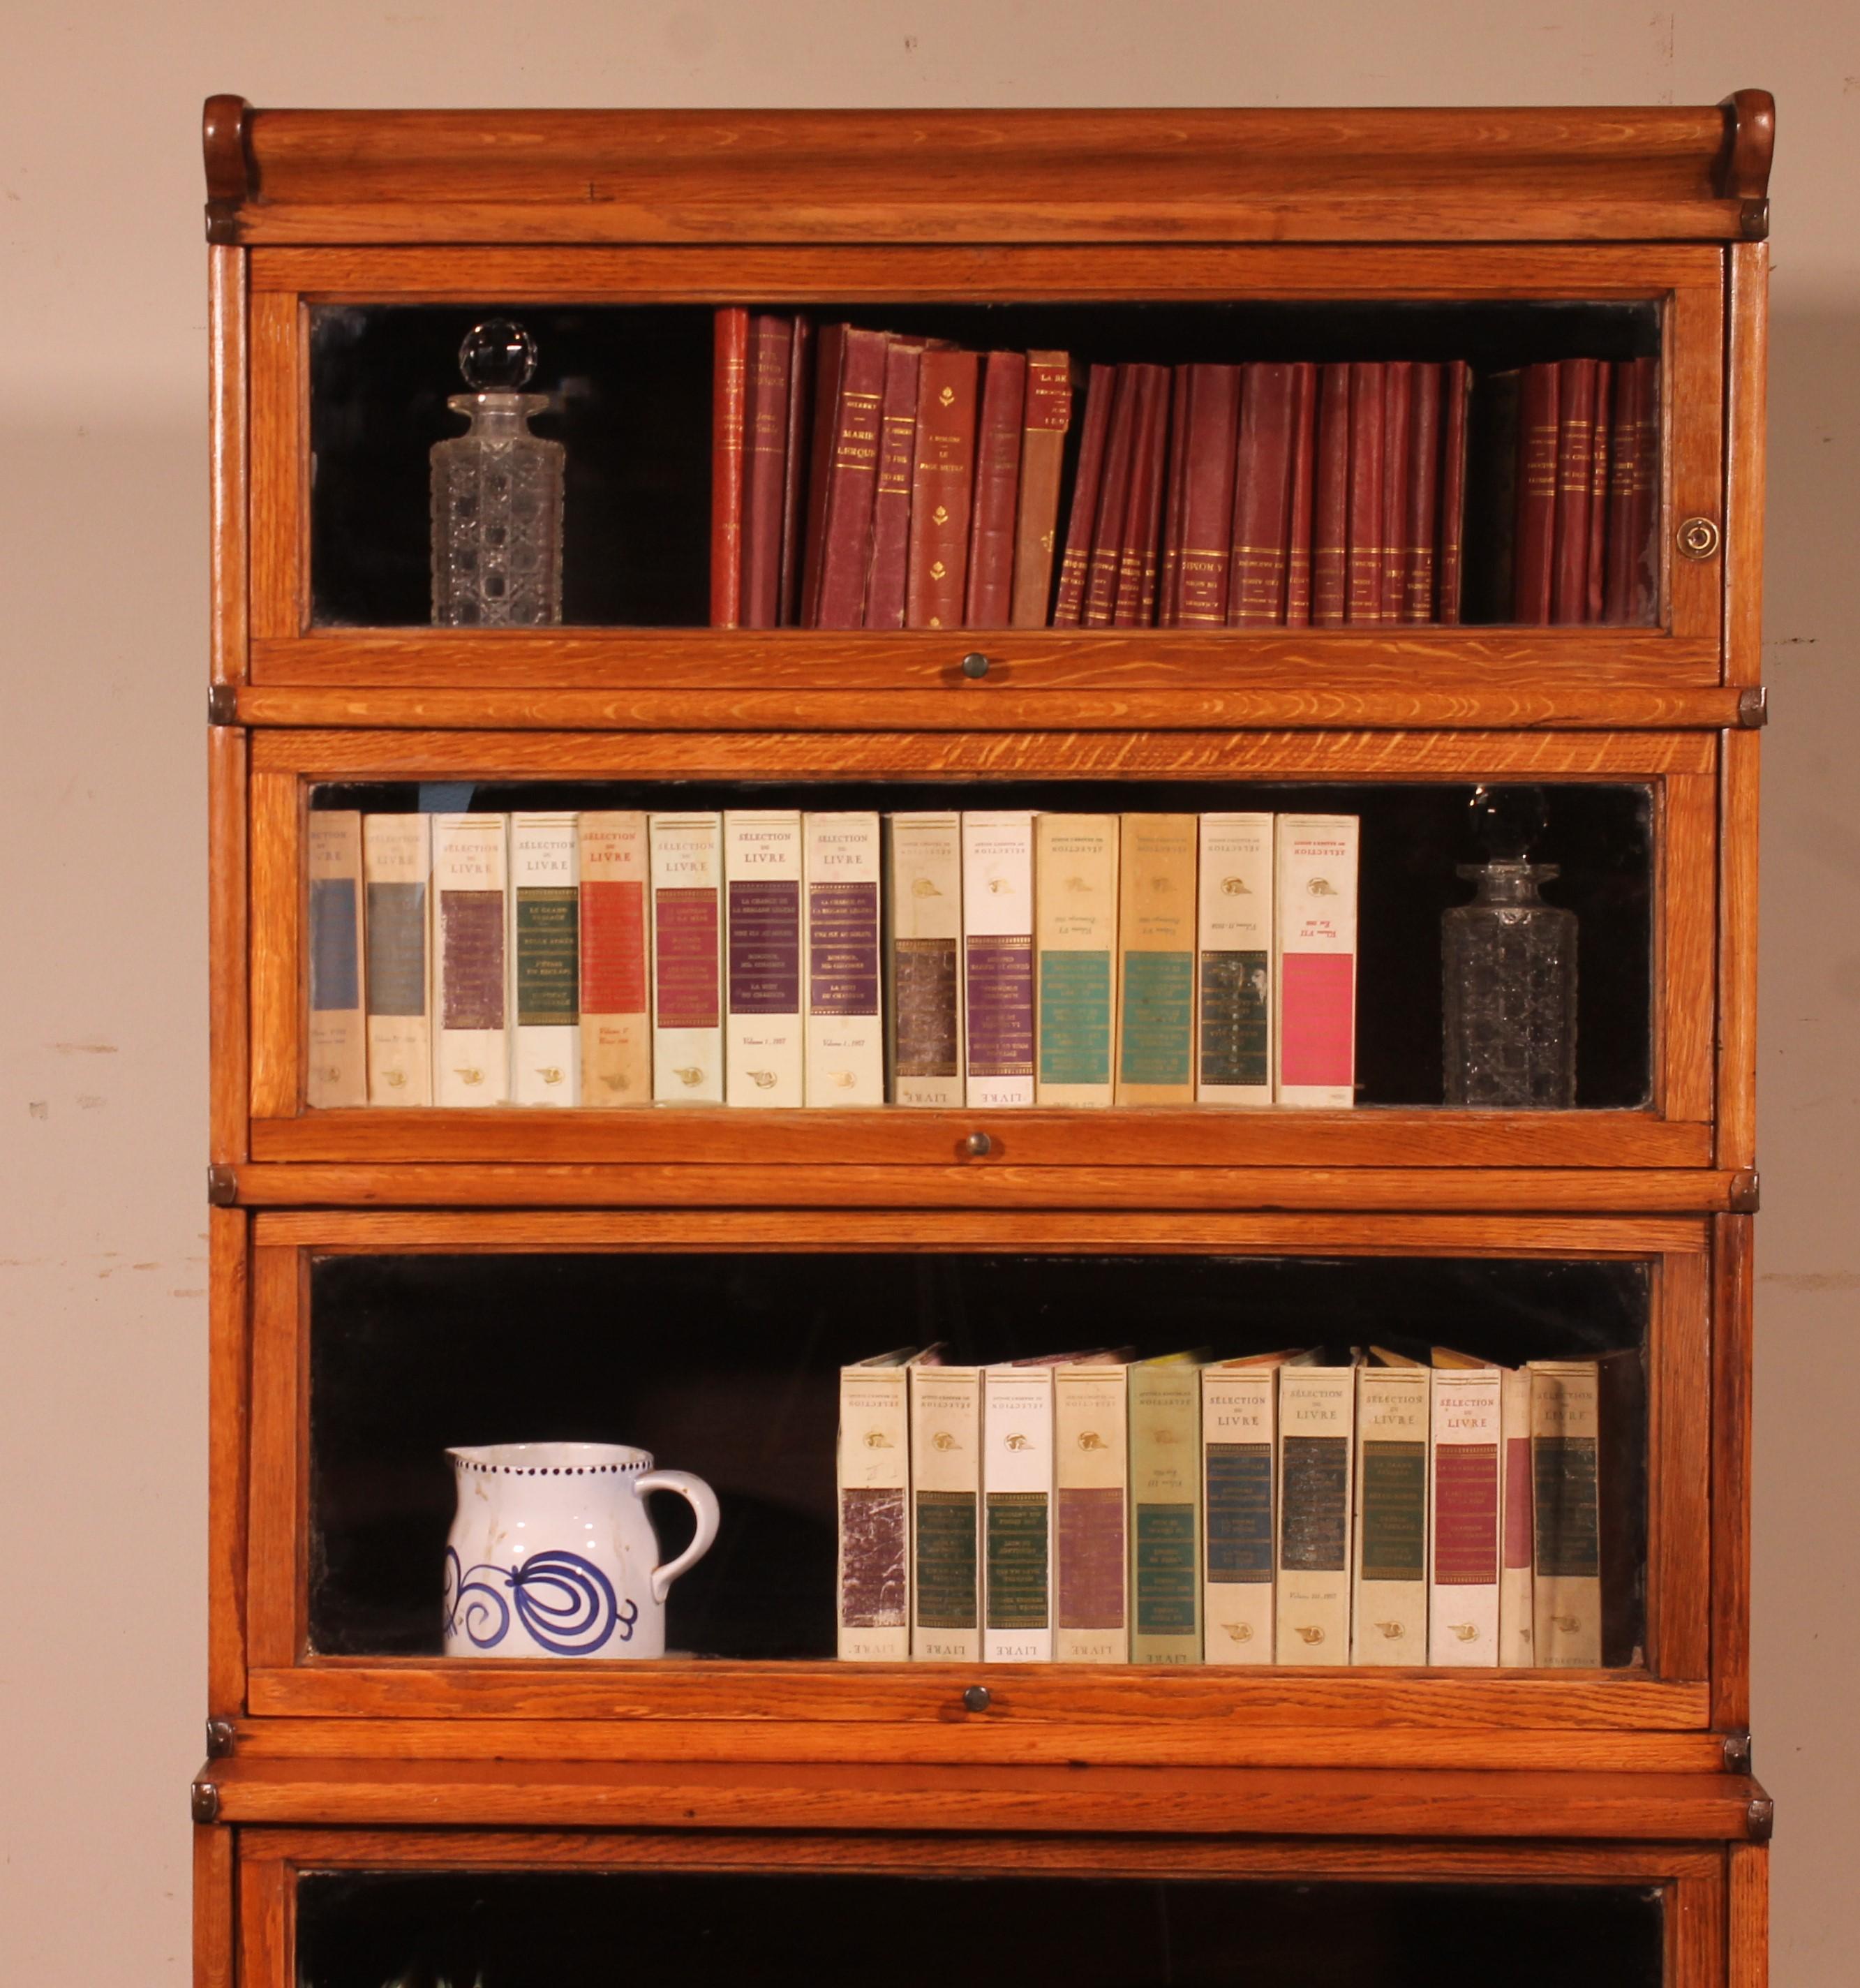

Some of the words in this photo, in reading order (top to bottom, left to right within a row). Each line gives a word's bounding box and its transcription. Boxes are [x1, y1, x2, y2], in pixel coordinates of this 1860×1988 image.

[738, 831, 791, 841] SÉLECTION
[377, 856, 415, 865] LIVRE
[590, 852, 632, 862] LIVRE
[744, 853, 787, 863] LIVRE
[824, 855, 863, 864] LIVRE
[451, 864, 493, 873] LIVRE
[527, 861, 569, 870] LIVRE
[666, 862, 708, 872] LIVRE
[907, 1093, 947, 1103] LIVRE
[982, 1093, 1022, 1103] LIVRE
[1210, 1395, 1267, 1405] SÉLECTION
[1439, 1398, 1494, 1407] SÉLECTION
[1296, 1410, 1337, 1420] LIVRE
[1374, 1415, 1415, 1425] LIVRE
[1218, 1416, 1259, 1426] LIVRE
[1448, 1418, 1488, 1428] LIVRE
[925, 1645, 965, 1655] LIVRE
[996, 1646, 1037, 1656] LIVRE
[1071, 1645, 1113, 1655] LIVRE
